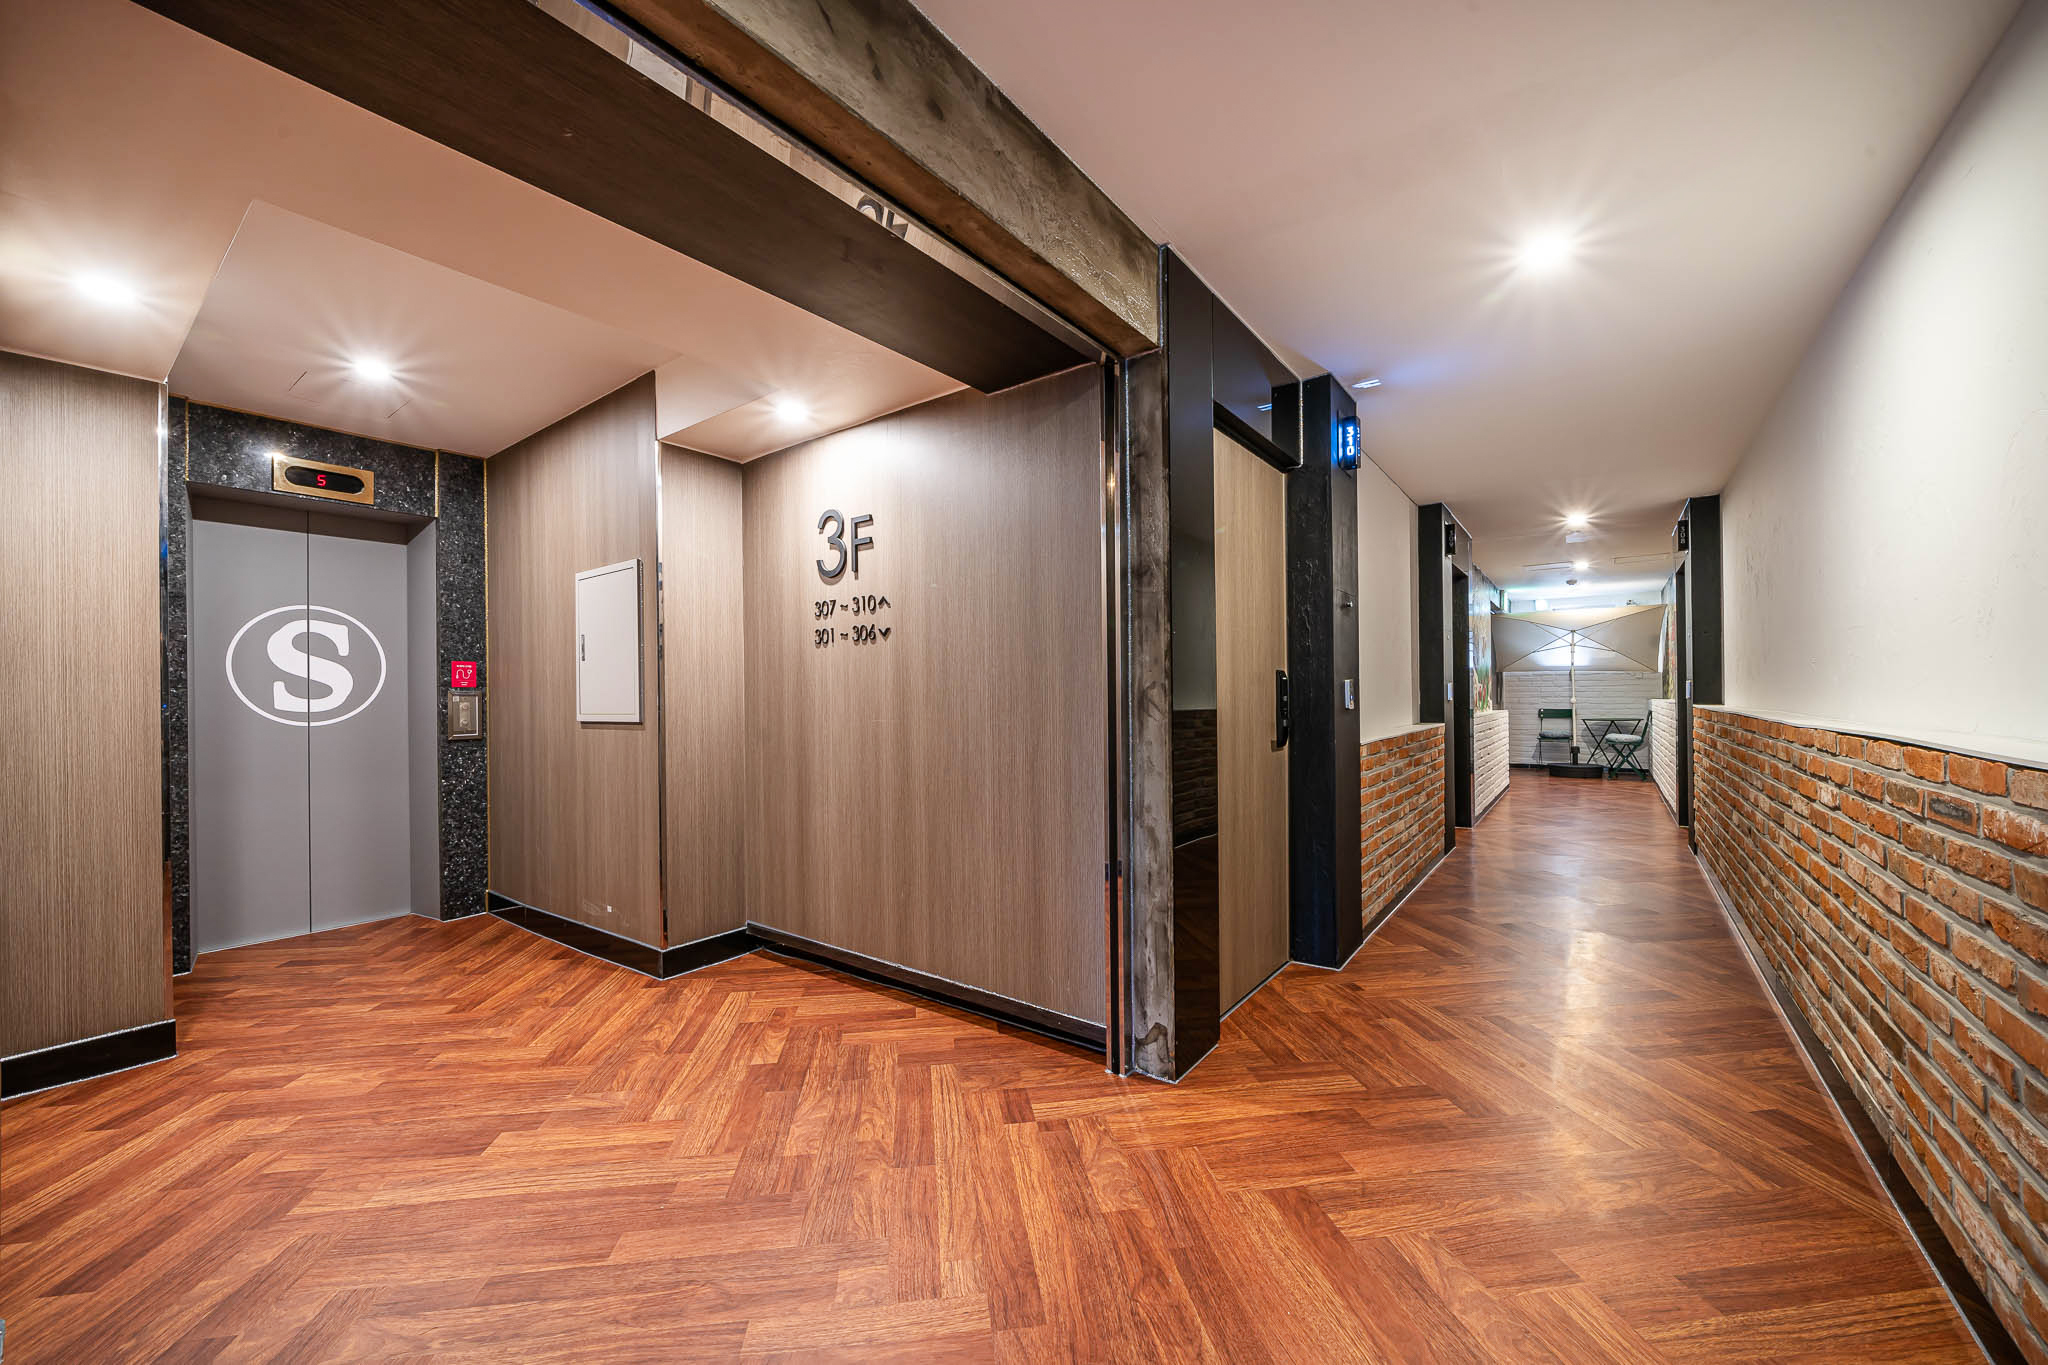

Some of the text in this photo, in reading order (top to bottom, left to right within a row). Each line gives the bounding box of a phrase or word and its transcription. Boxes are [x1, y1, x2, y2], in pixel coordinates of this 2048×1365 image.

[1346, 425, 1355, 456] 310
[816, 508, 873, 579] 3F
[815, 599, 837, 619] 307
[852, 595, 877, 616] 310
[815, 628, 835, 646] 301
[852, 624, 877, 643] 306
[267, 619, 354, 713] S
